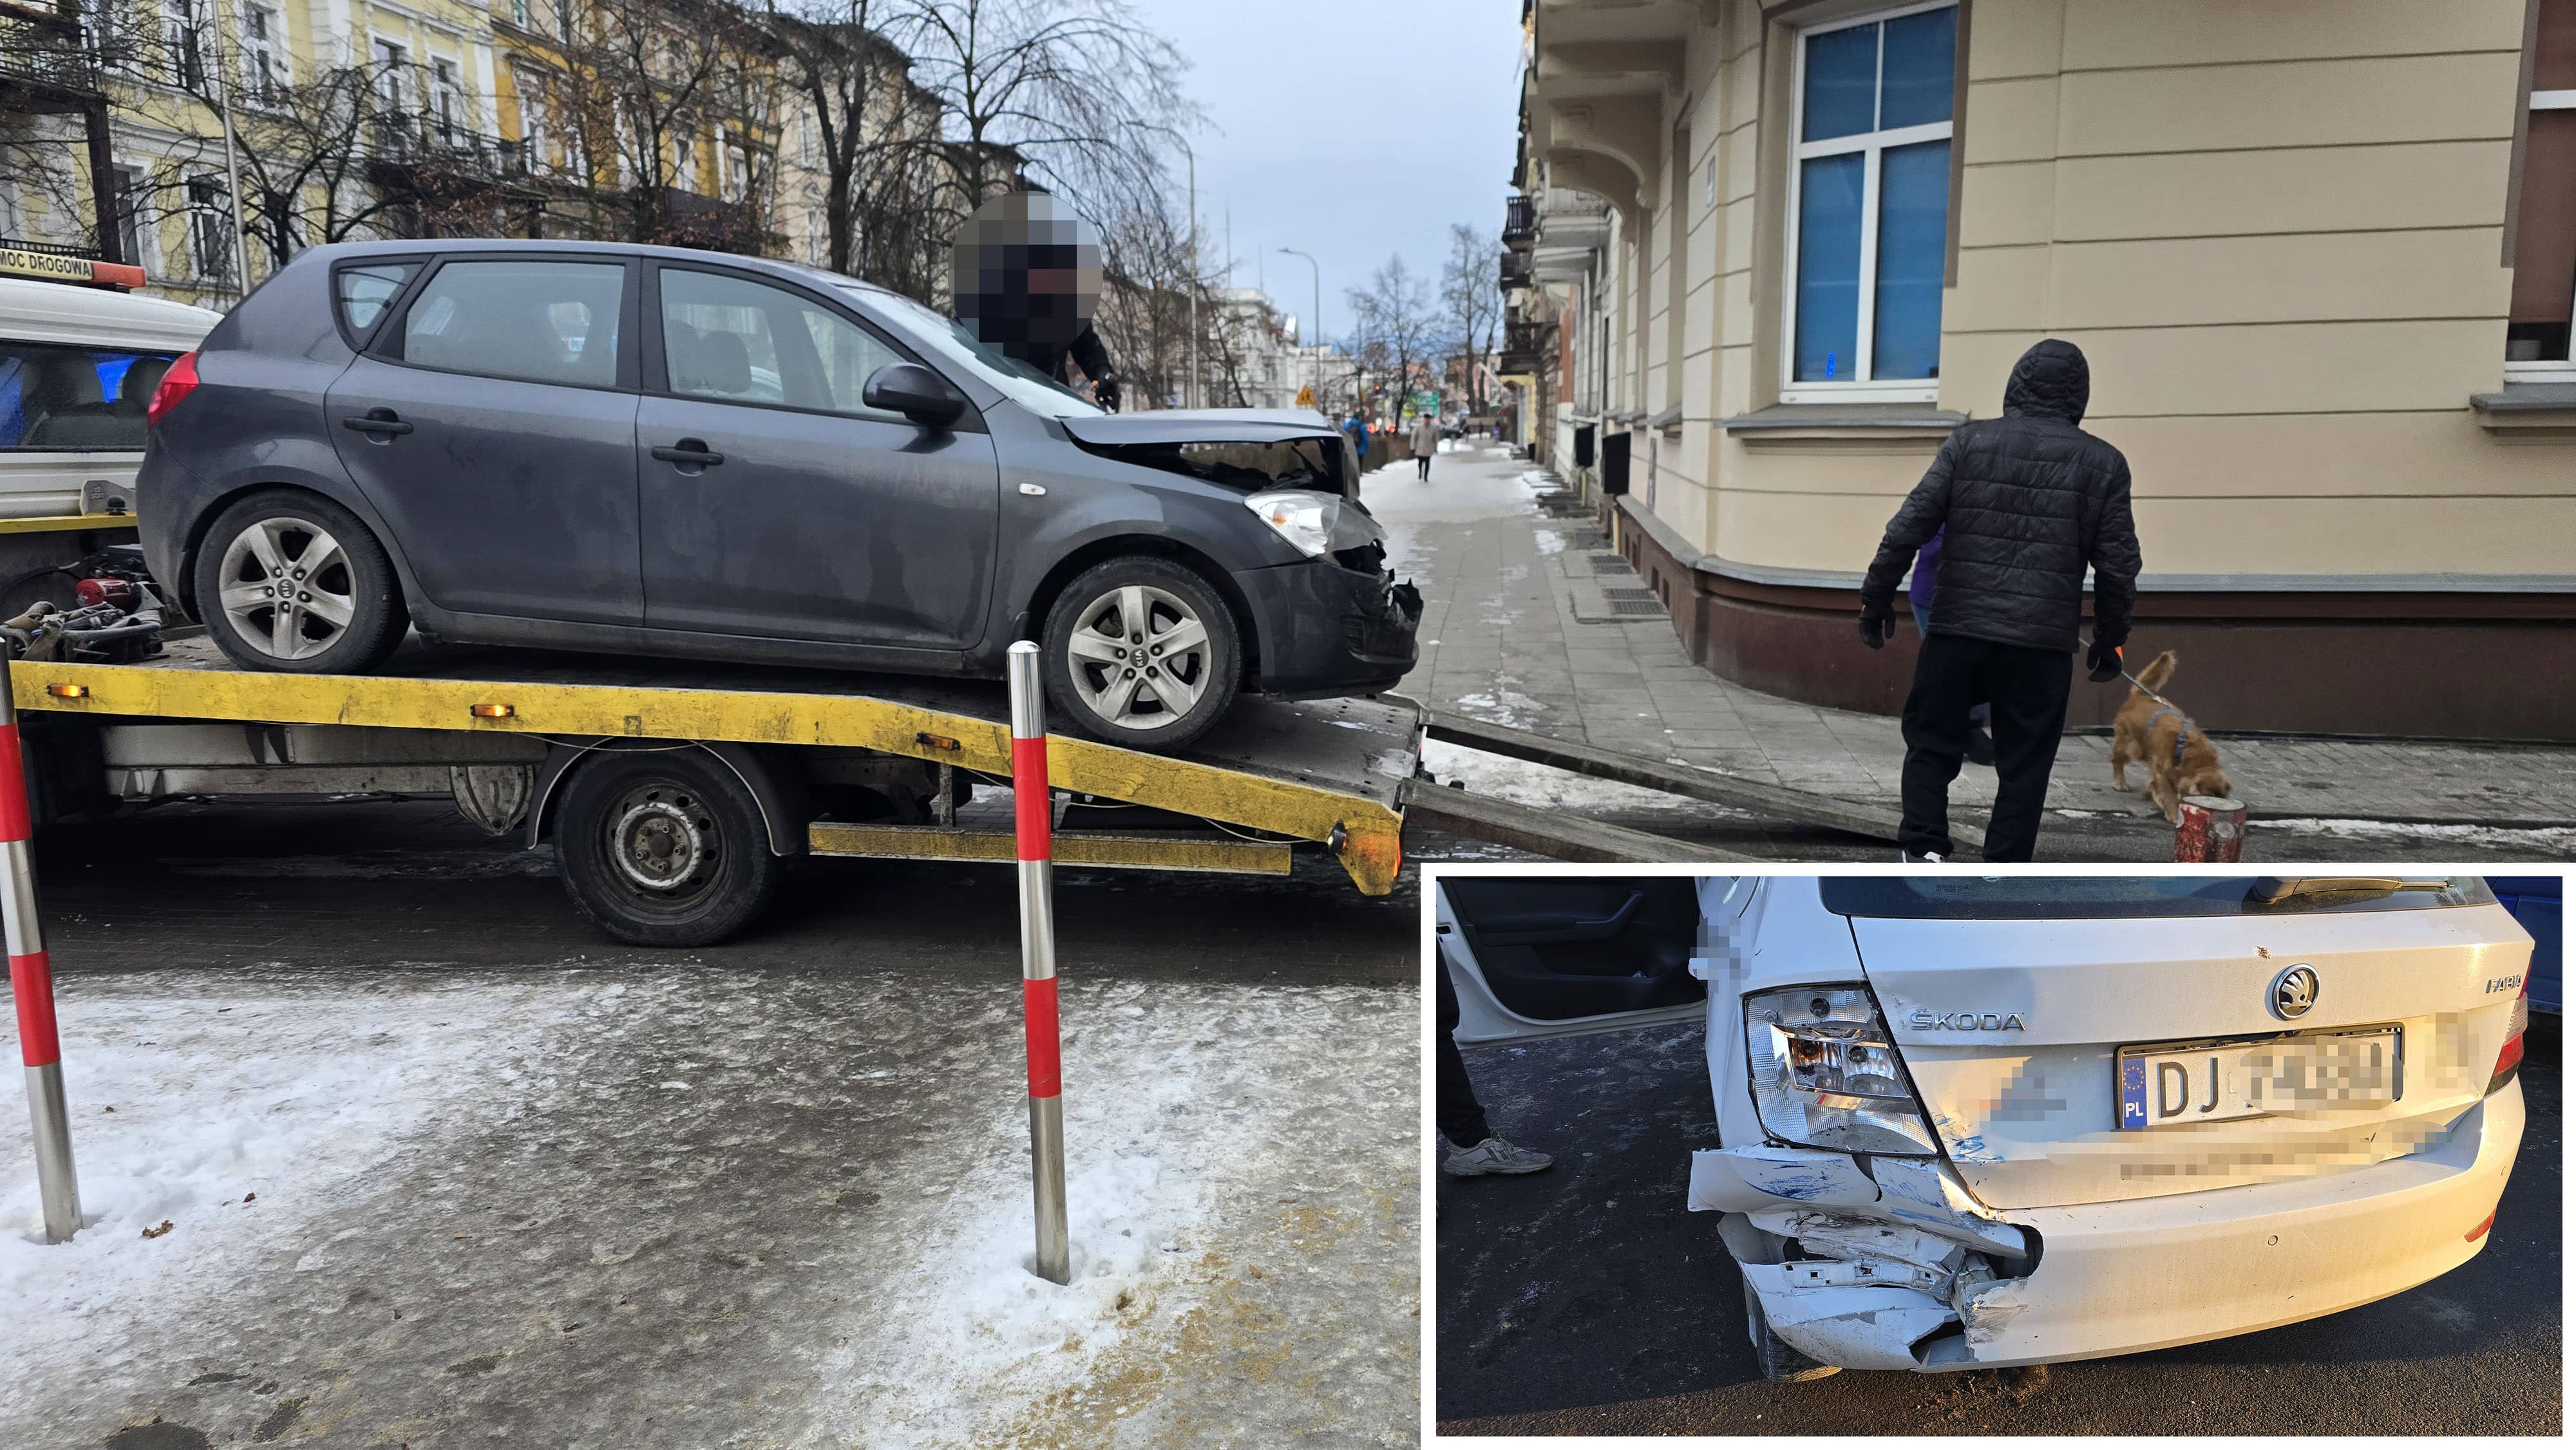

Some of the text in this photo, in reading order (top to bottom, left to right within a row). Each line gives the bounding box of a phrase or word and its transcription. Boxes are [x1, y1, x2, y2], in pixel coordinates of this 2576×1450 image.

[29, 254, 90, 276] DROGOWA
[2486, 974, 2521, 993] FABIA
[1910, 1008, 2025, 1031] ŠKODA
[2125, 1103, 2144, 1117] PL
